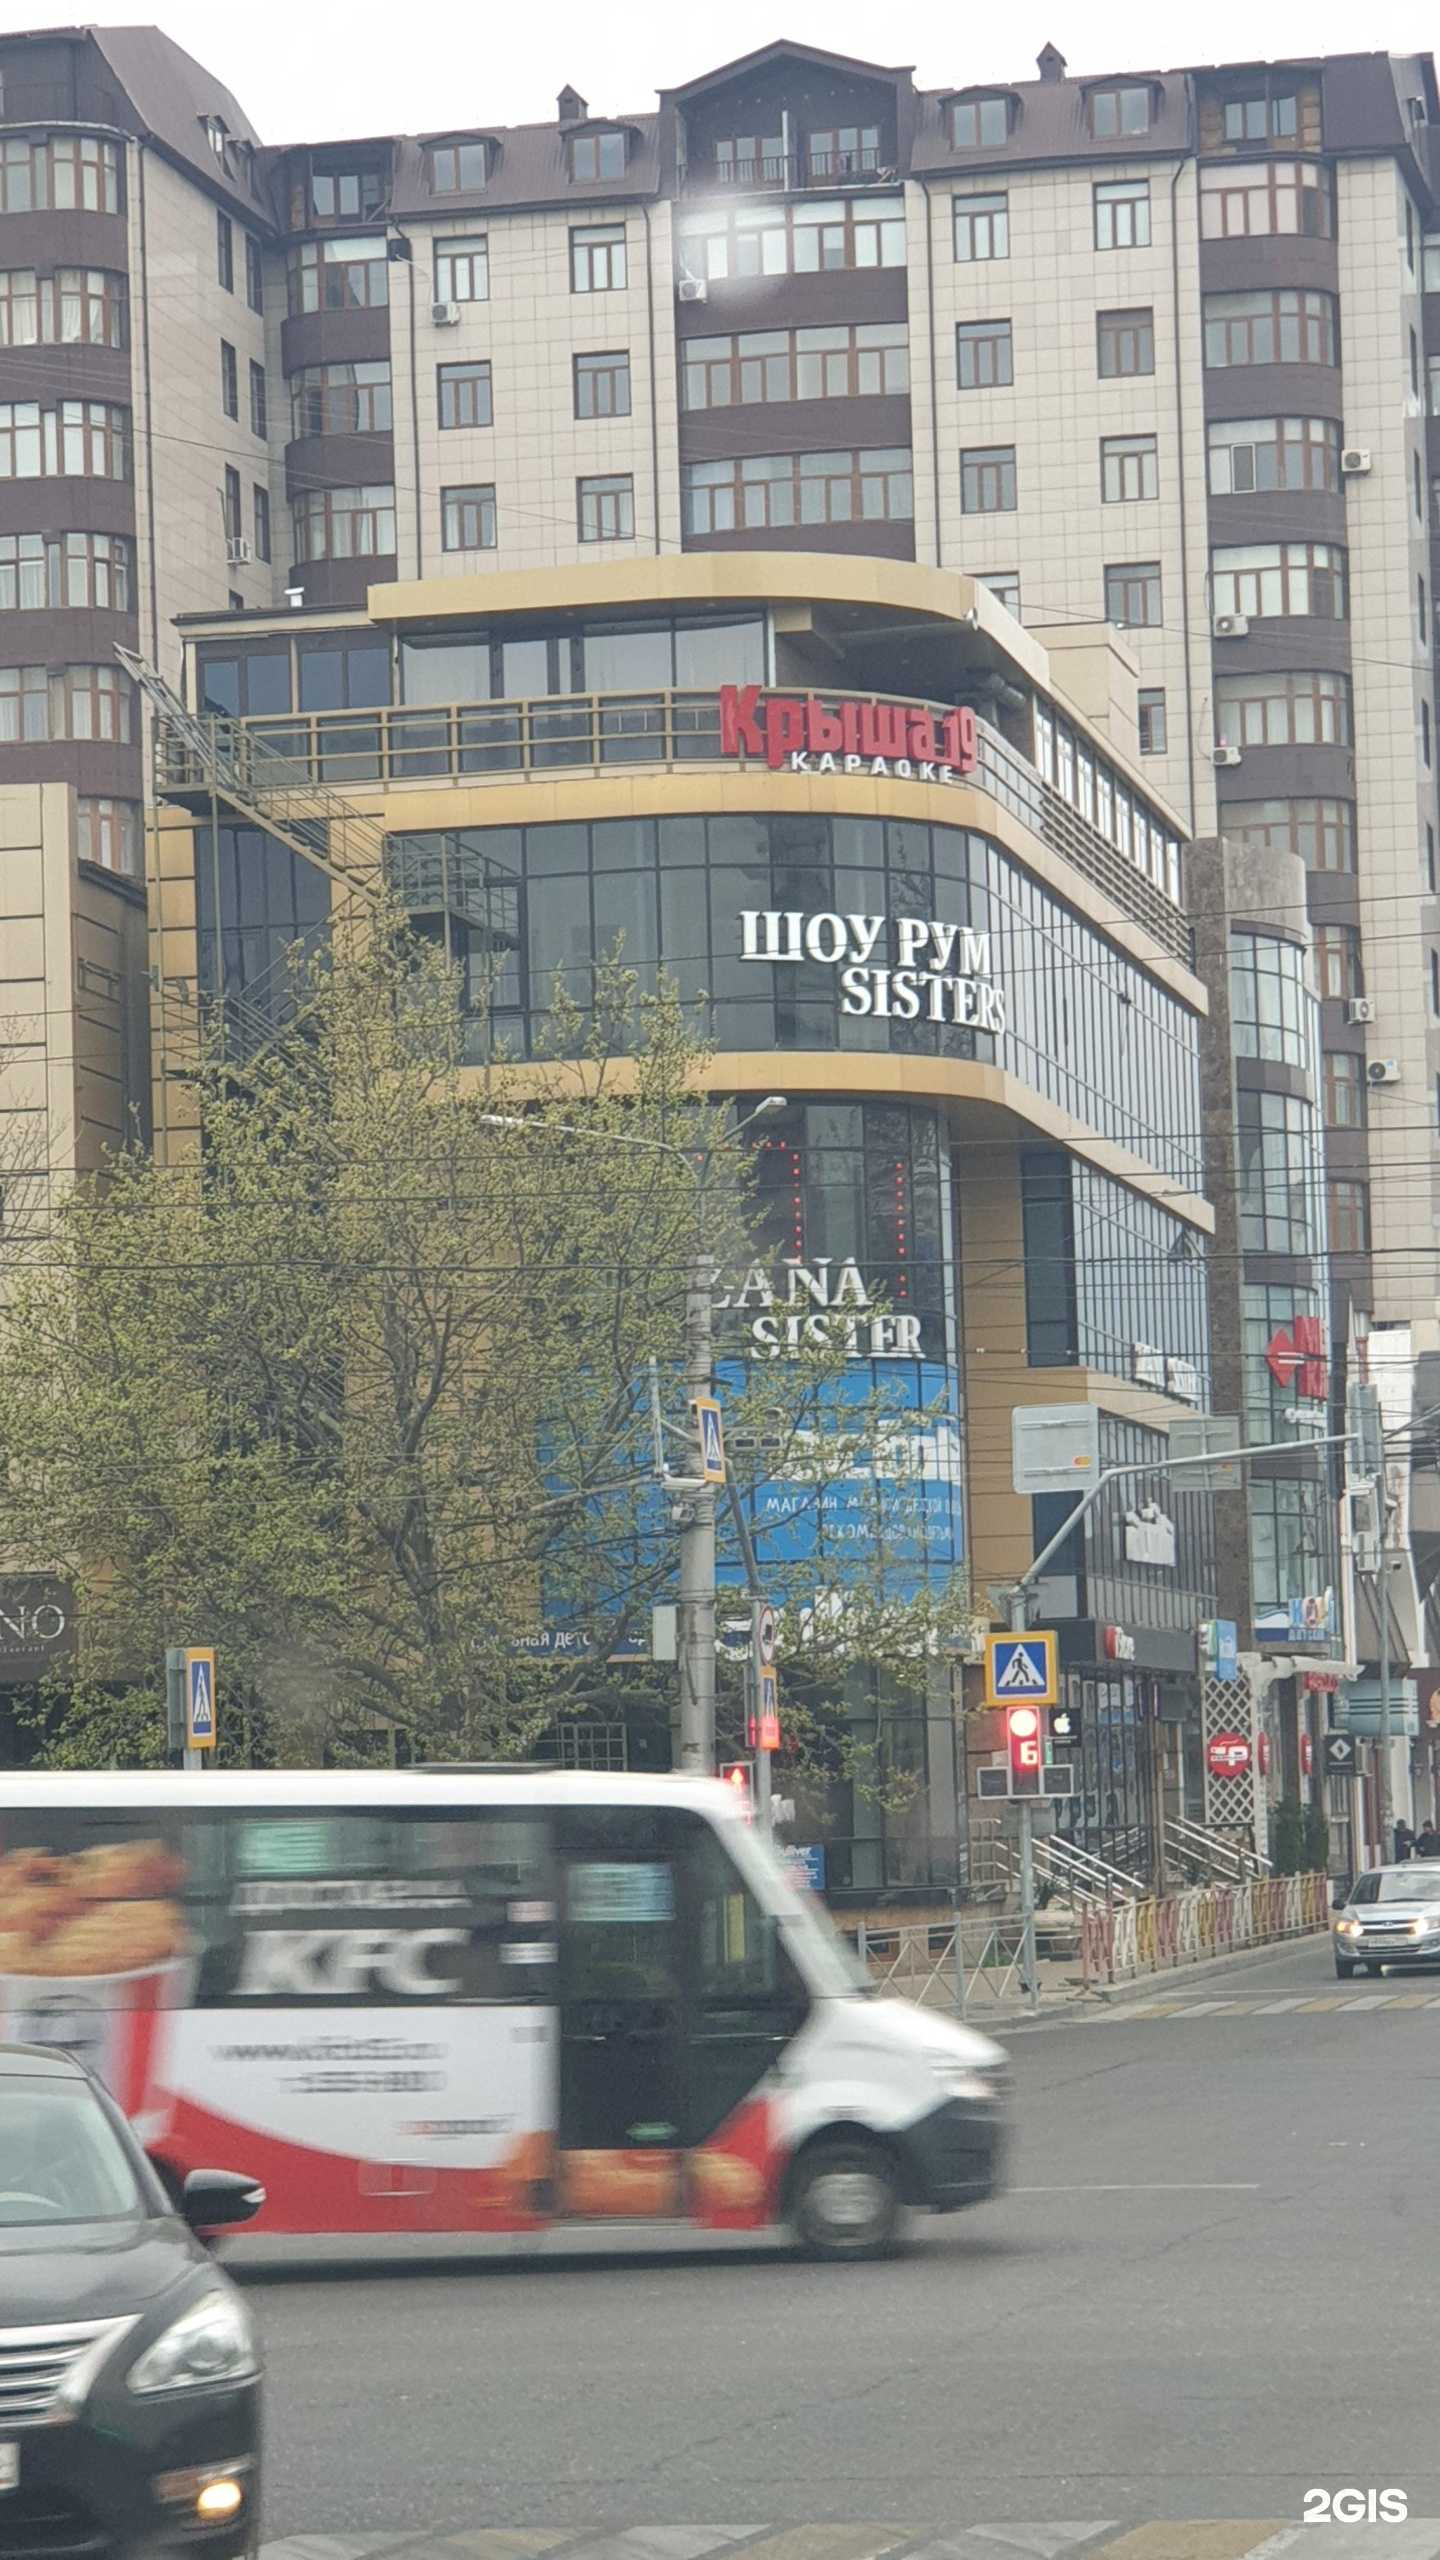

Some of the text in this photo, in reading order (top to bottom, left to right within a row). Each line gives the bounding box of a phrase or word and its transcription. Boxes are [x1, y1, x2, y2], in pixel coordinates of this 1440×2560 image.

[720, 684, 935, 768] Крыша
[791, 751, 954, 784] КАРАОКЕ
[739, 909, 992, 979] ШОУ РУМ
[840, 966, 1006, 1034] SISTERS
[751, 1314, 927, 1359] SISTER
[1020, 1740, 1039, 1766] 6
[227, 1927, 473, 1995] KFC
